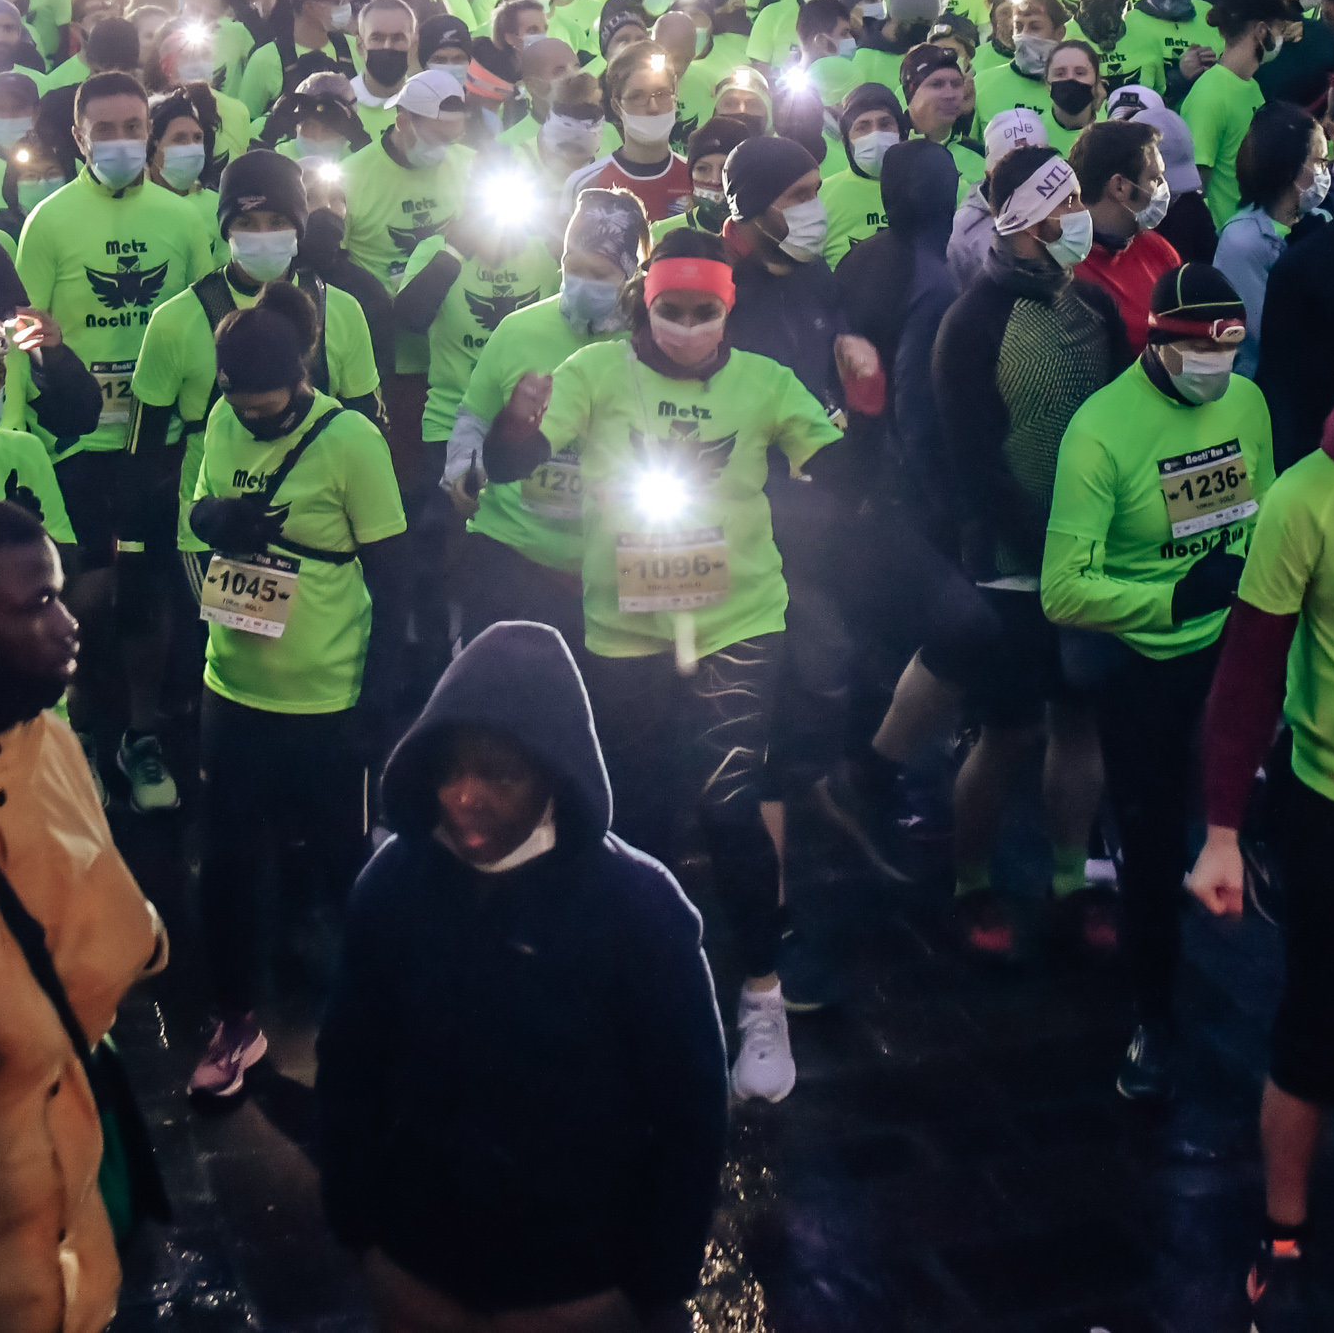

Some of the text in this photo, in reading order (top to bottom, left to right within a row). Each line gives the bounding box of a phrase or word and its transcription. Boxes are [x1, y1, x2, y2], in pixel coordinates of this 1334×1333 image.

[1165, 37, 1190, 47] Metz
[1004, 123, 1034, 139] DNB
[402, 198, 436, 213] Metz
[867, 212, 889, 226] Me
[106, 239, 148, 255] Metz
[480, 269, 519, 283] Metz
[85, 312, 152, 328] Nocti'R
[103, 380, 133, 399] 12
[658, 400, 712, 420] Metz
[233, 469, 271, 488] Met
[539, 468, 582, 495] 120
[1179, 465, 1238, 503] 1236
[638, 555, 710, 580] 1096
[219, 570, 280, 604] 1045
